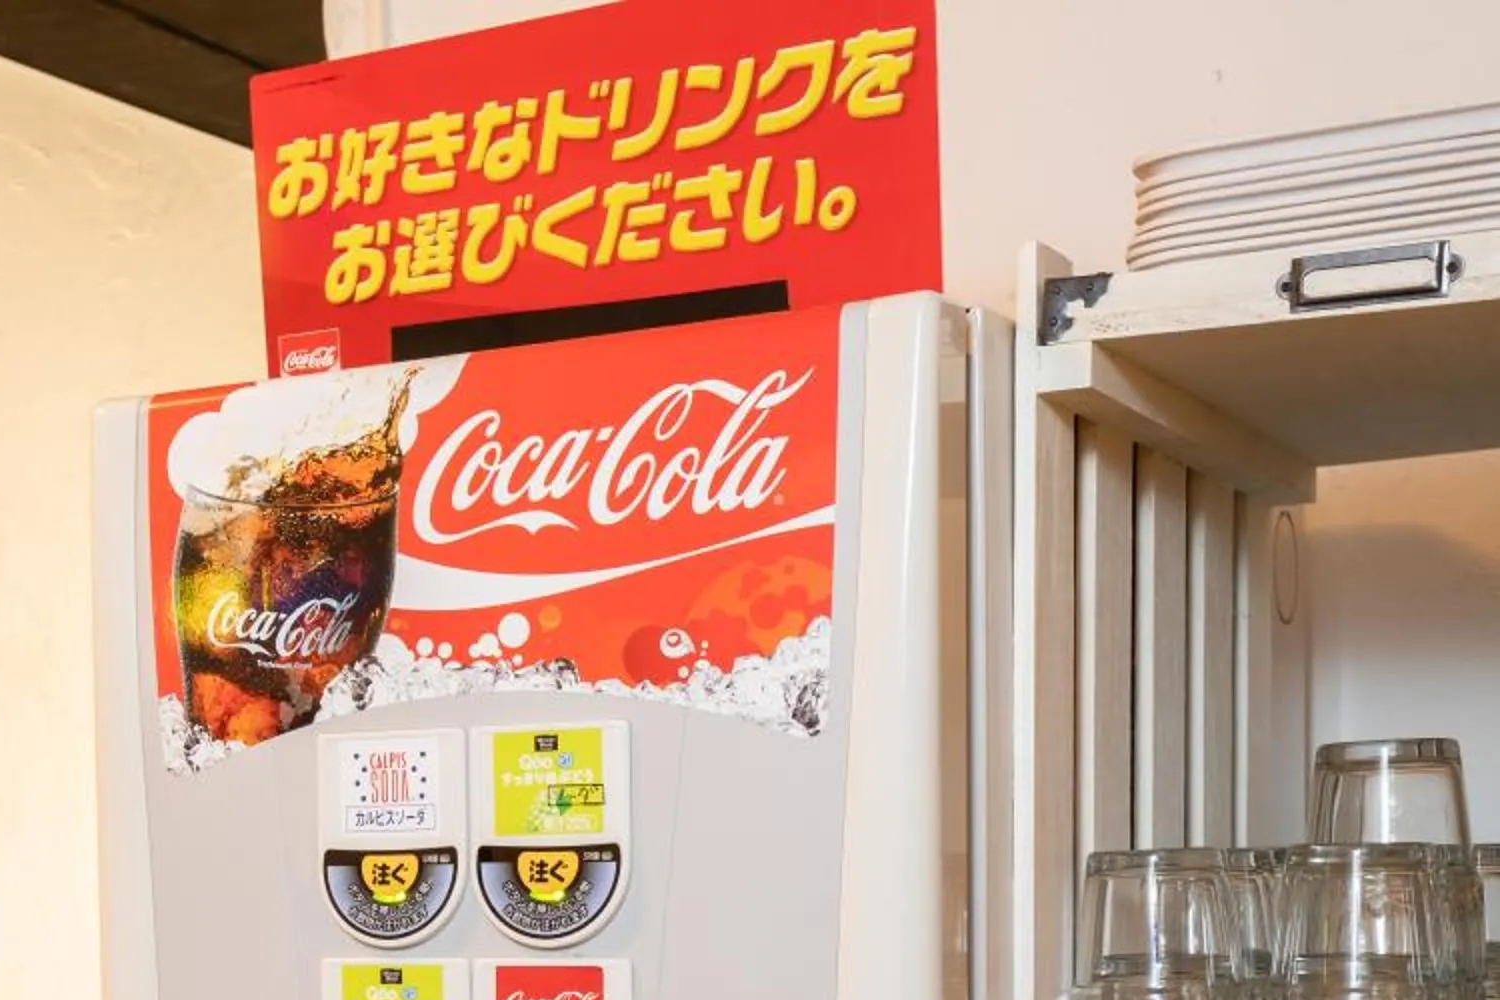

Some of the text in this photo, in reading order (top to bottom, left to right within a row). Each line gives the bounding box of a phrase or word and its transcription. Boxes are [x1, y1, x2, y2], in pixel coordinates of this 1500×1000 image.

[267, 26, 917, 221] お好きなドリンクを
[323, 156, 857, 306] お選びください。
[411, 364, 816, 545] Coca-Cola
[206, 591, 361, 658] Coca-Cola
[369, 751, 408, 771] CALPIS
[369, 769, 411, 805] SODA
[354, 806, 427, 827] カルピスソーダ
[371, 862, 410, 886] 注ぐ
[529, 859, 568, 883] 注ぐ
